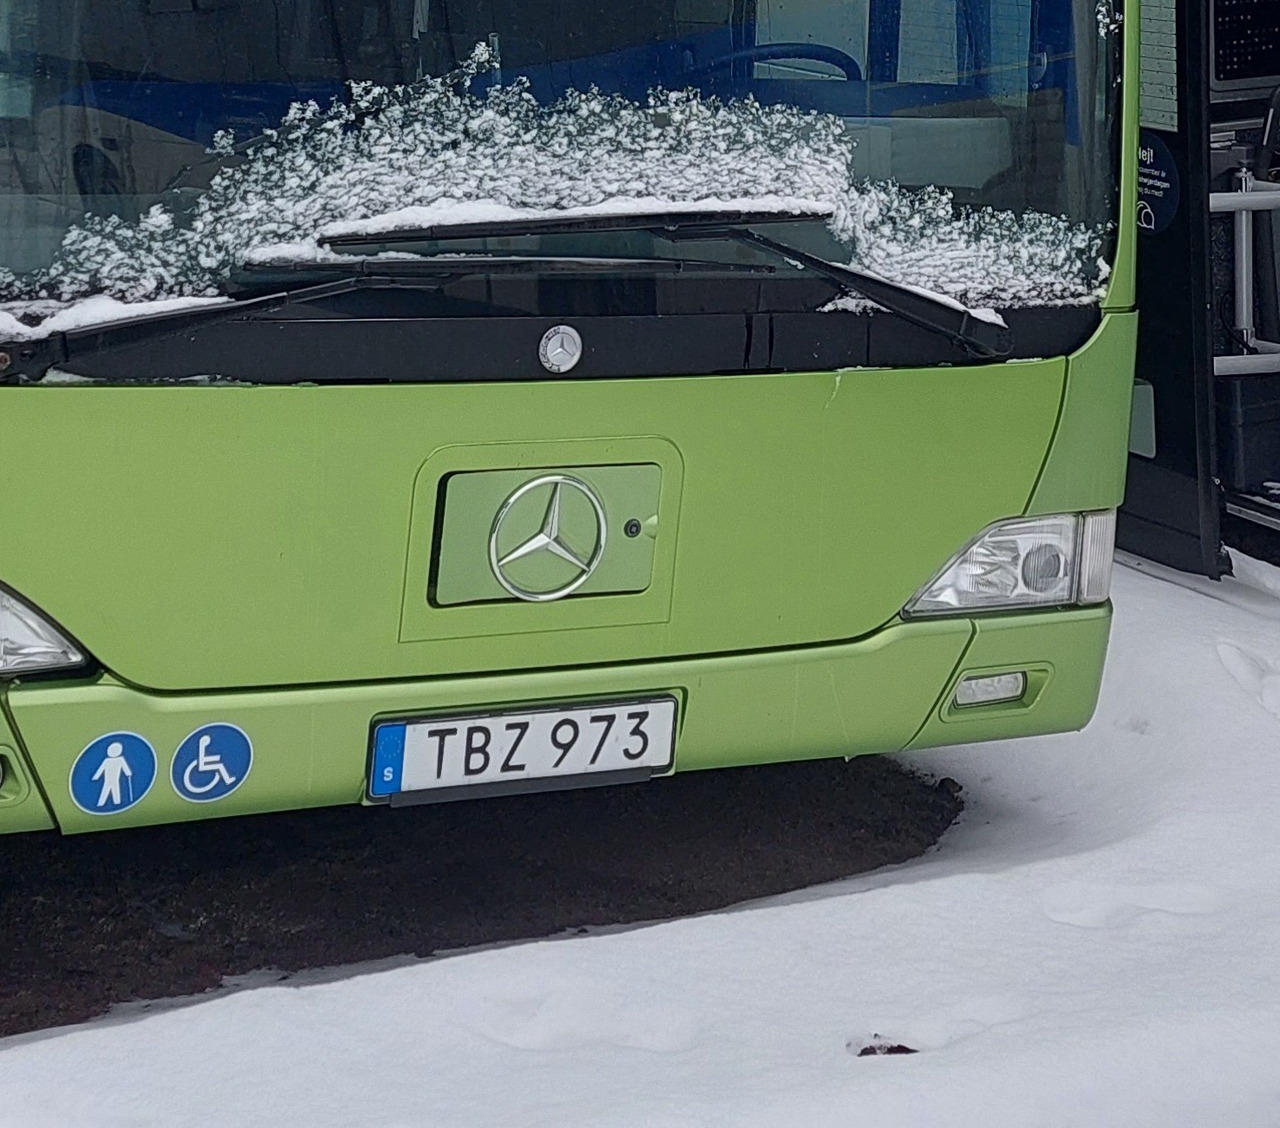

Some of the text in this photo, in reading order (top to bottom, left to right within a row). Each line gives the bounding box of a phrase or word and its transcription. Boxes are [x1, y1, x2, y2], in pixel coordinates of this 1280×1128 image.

[383, 710, 651, 782] S TBZ 973
